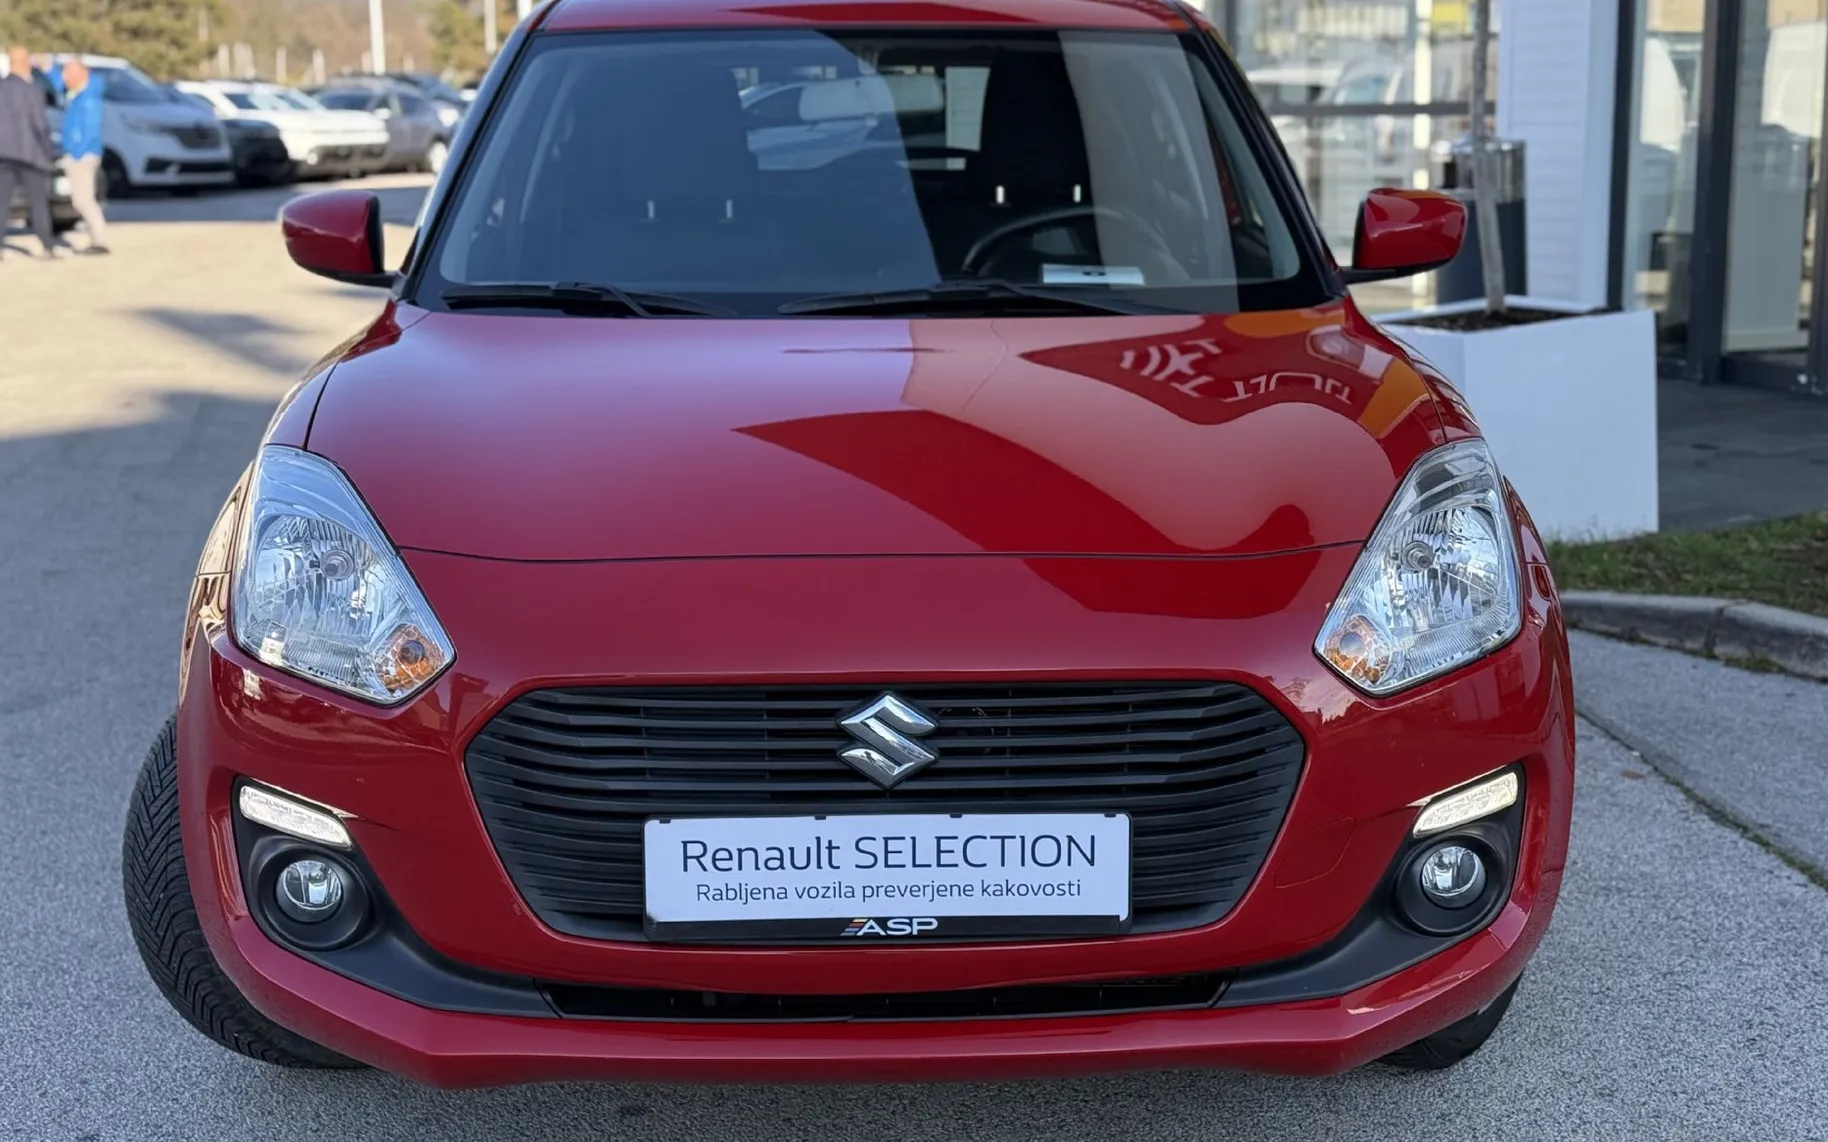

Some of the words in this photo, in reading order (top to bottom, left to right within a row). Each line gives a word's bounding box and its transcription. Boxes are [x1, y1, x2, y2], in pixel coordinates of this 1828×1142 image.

[680, 835, 841, 873] Renault
[854, 834, 1096, 870] SELECTION
[696, 882, 788, 906] Rabljena
[794, 880, 856, 900] vozila
[861, 880, 975, 904] preverjene
[980, 878, 1081, 897] kakovosti
[856, 918, 938, 936] ASP
